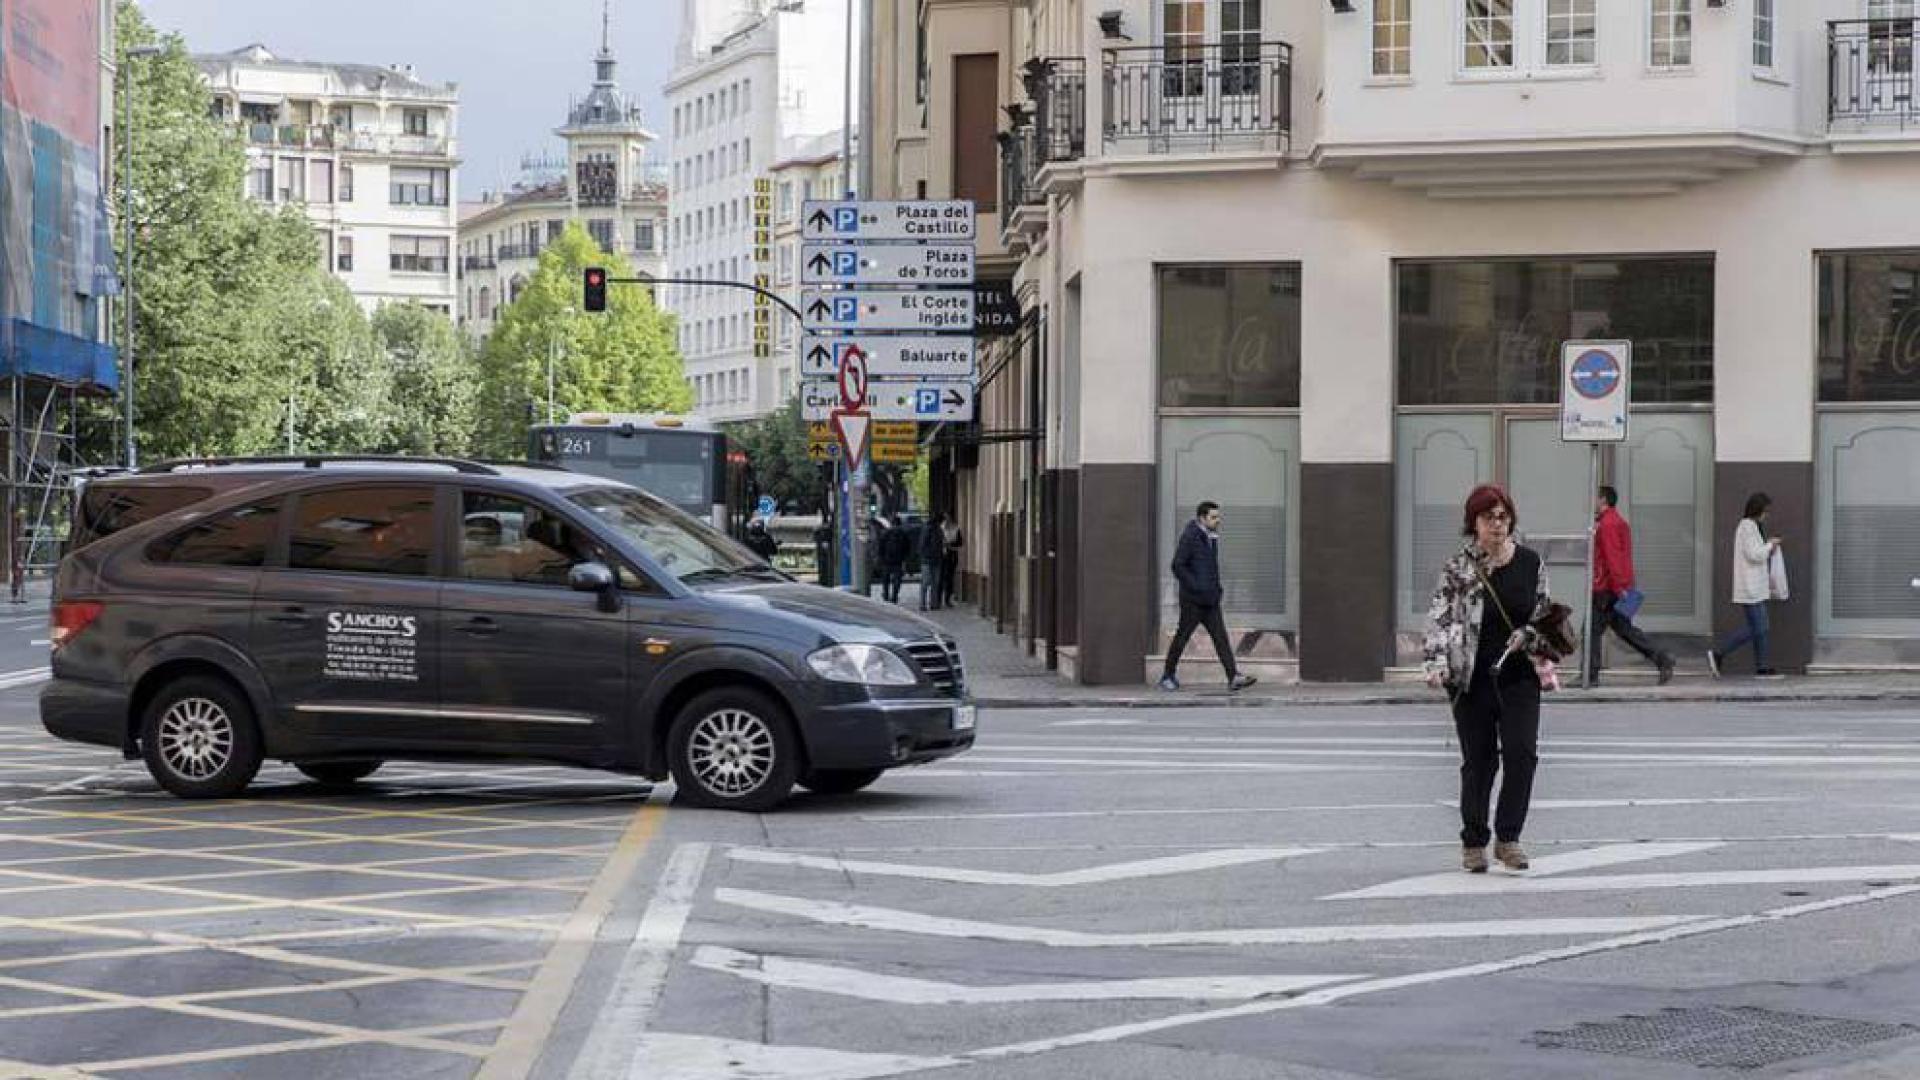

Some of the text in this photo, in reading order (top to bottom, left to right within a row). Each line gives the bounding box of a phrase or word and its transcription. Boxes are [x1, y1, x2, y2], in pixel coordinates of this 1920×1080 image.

[896, 205, 969, 218] Plaza del
[905, 220, 969, 233] Castillo
[926, 250, 968, 263] Plaza
[898, 265, 969, 278] de Toros
[901, 296, 968, 309] El Corte
[976, 292, 1003, 304] TEL
[919, 310, 968, 326] Inglés
[975, 312, 1013, 325] NIDA
[901, 349, 968, 362] Baluarte
[806, 394, 839, 407] Carl
[560, 438, 591, 454] 261
[327, 612, 416, 636] SANCHO'S
